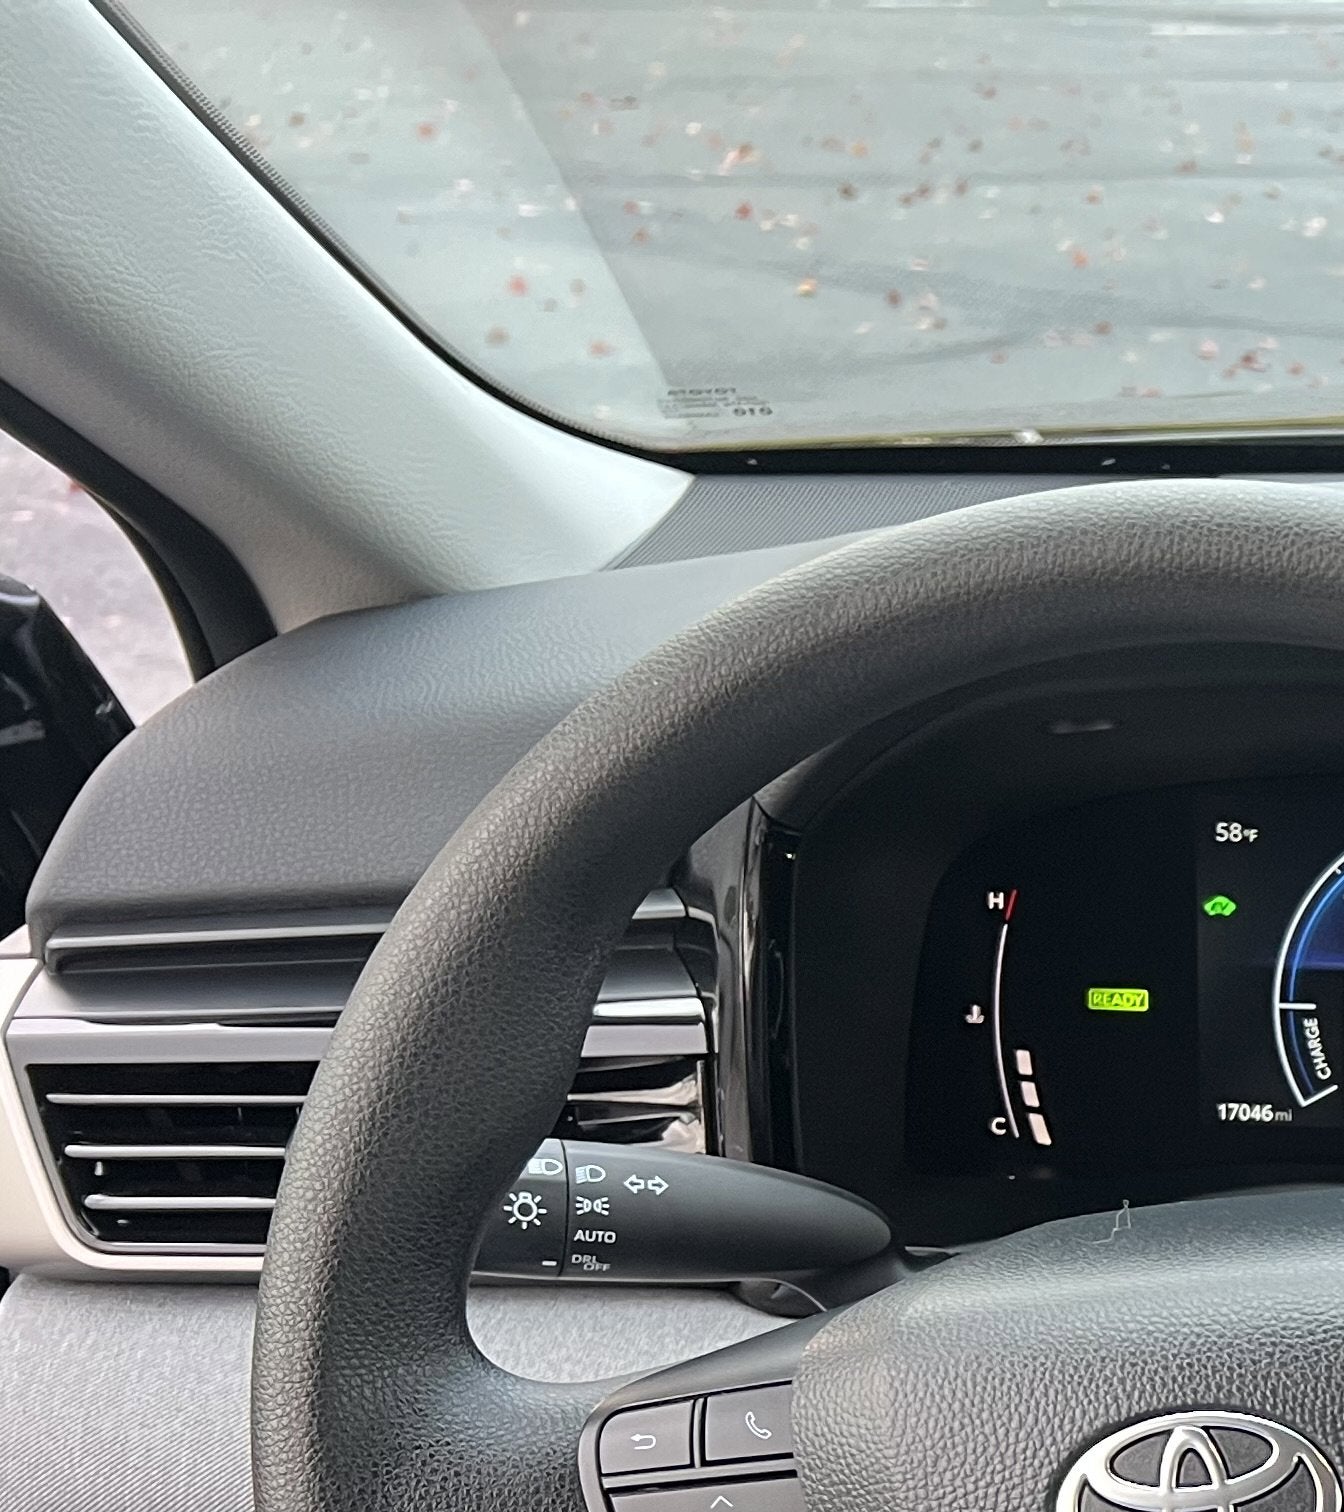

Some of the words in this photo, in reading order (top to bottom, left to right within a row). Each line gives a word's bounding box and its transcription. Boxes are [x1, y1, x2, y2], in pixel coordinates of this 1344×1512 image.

[988, 892, 1004, 910] H
[1093, 991, 1146, 1008] READY
[1303, 1018, 1332, 1080] CHARGE
[991, 1117, 1007, 1136] C
[573, 1229, 616, 1244] AUTO
[571, 1254, 598, 1264] DRL
